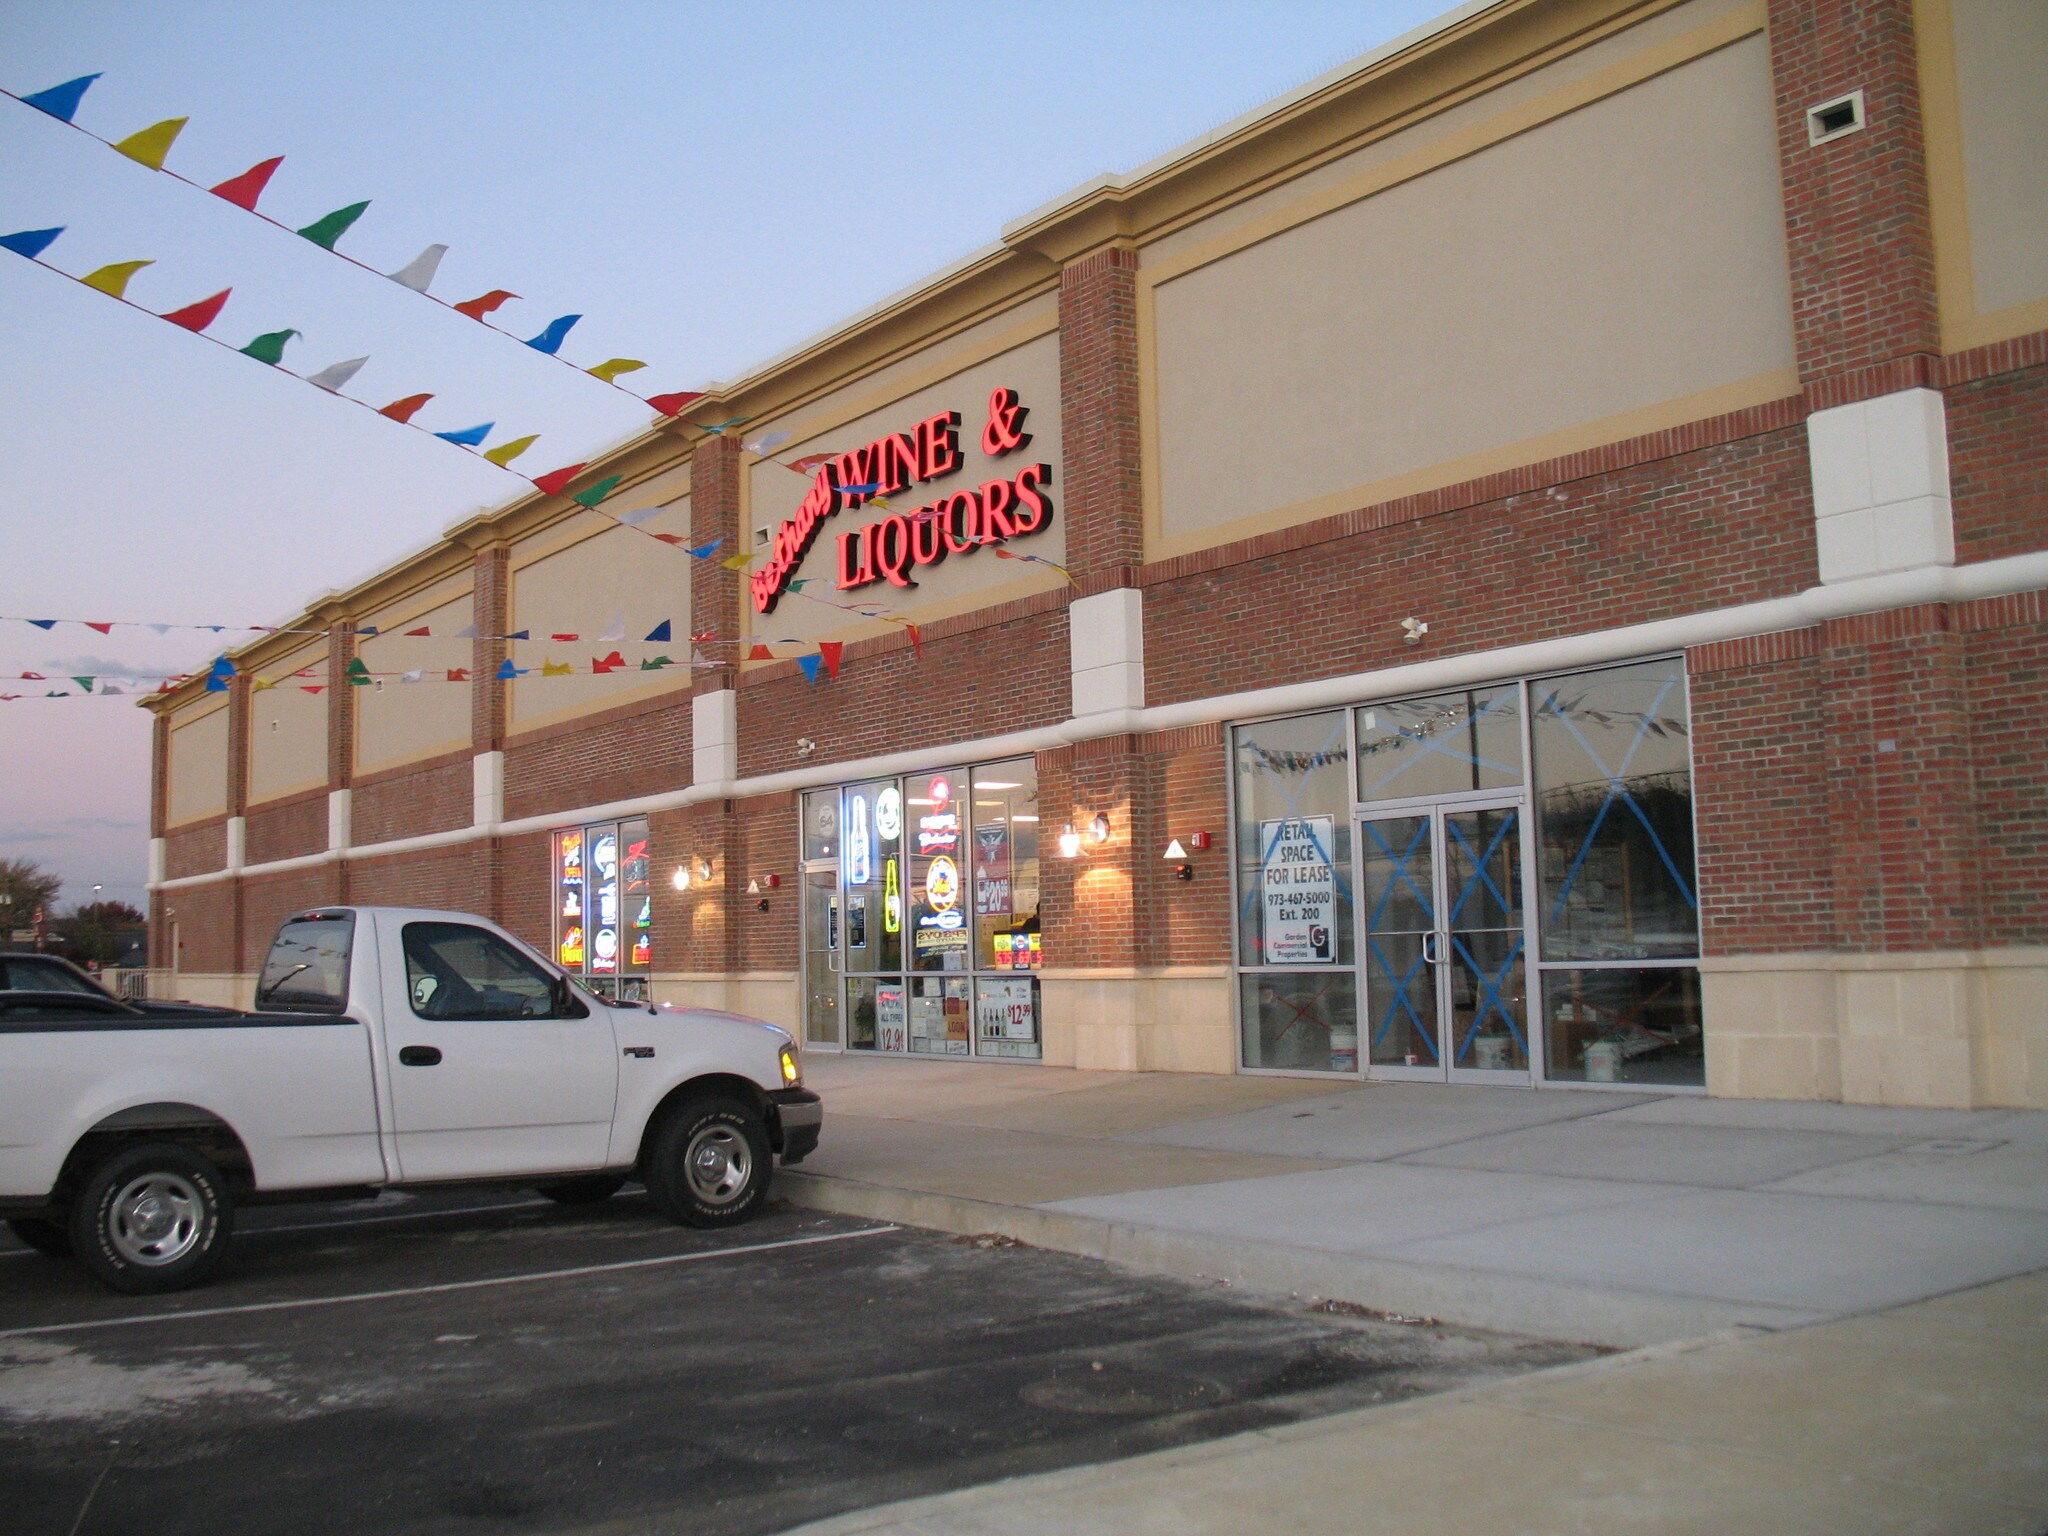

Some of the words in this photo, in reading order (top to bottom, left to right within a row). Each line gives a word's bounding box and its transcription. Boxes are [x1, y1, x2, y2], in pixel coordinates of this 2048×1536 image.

[835, 411, 964, 509] WINE
[982, 386, 1033, 457] &
[836, 462, 1053, 592] LIQUORS
[1280, 844, 1315, 863] SPACE
[1266, 868, 1289, 886] FOR
[1294, 865, 1330, 884] LEASE
[1268, 891, 1330, 907] 973-467-5000
[1279, 908, 1299, 921] Ext.
[1302, 907, 1320, 920] 200
[1284, 933, 1308, 942] Garden
